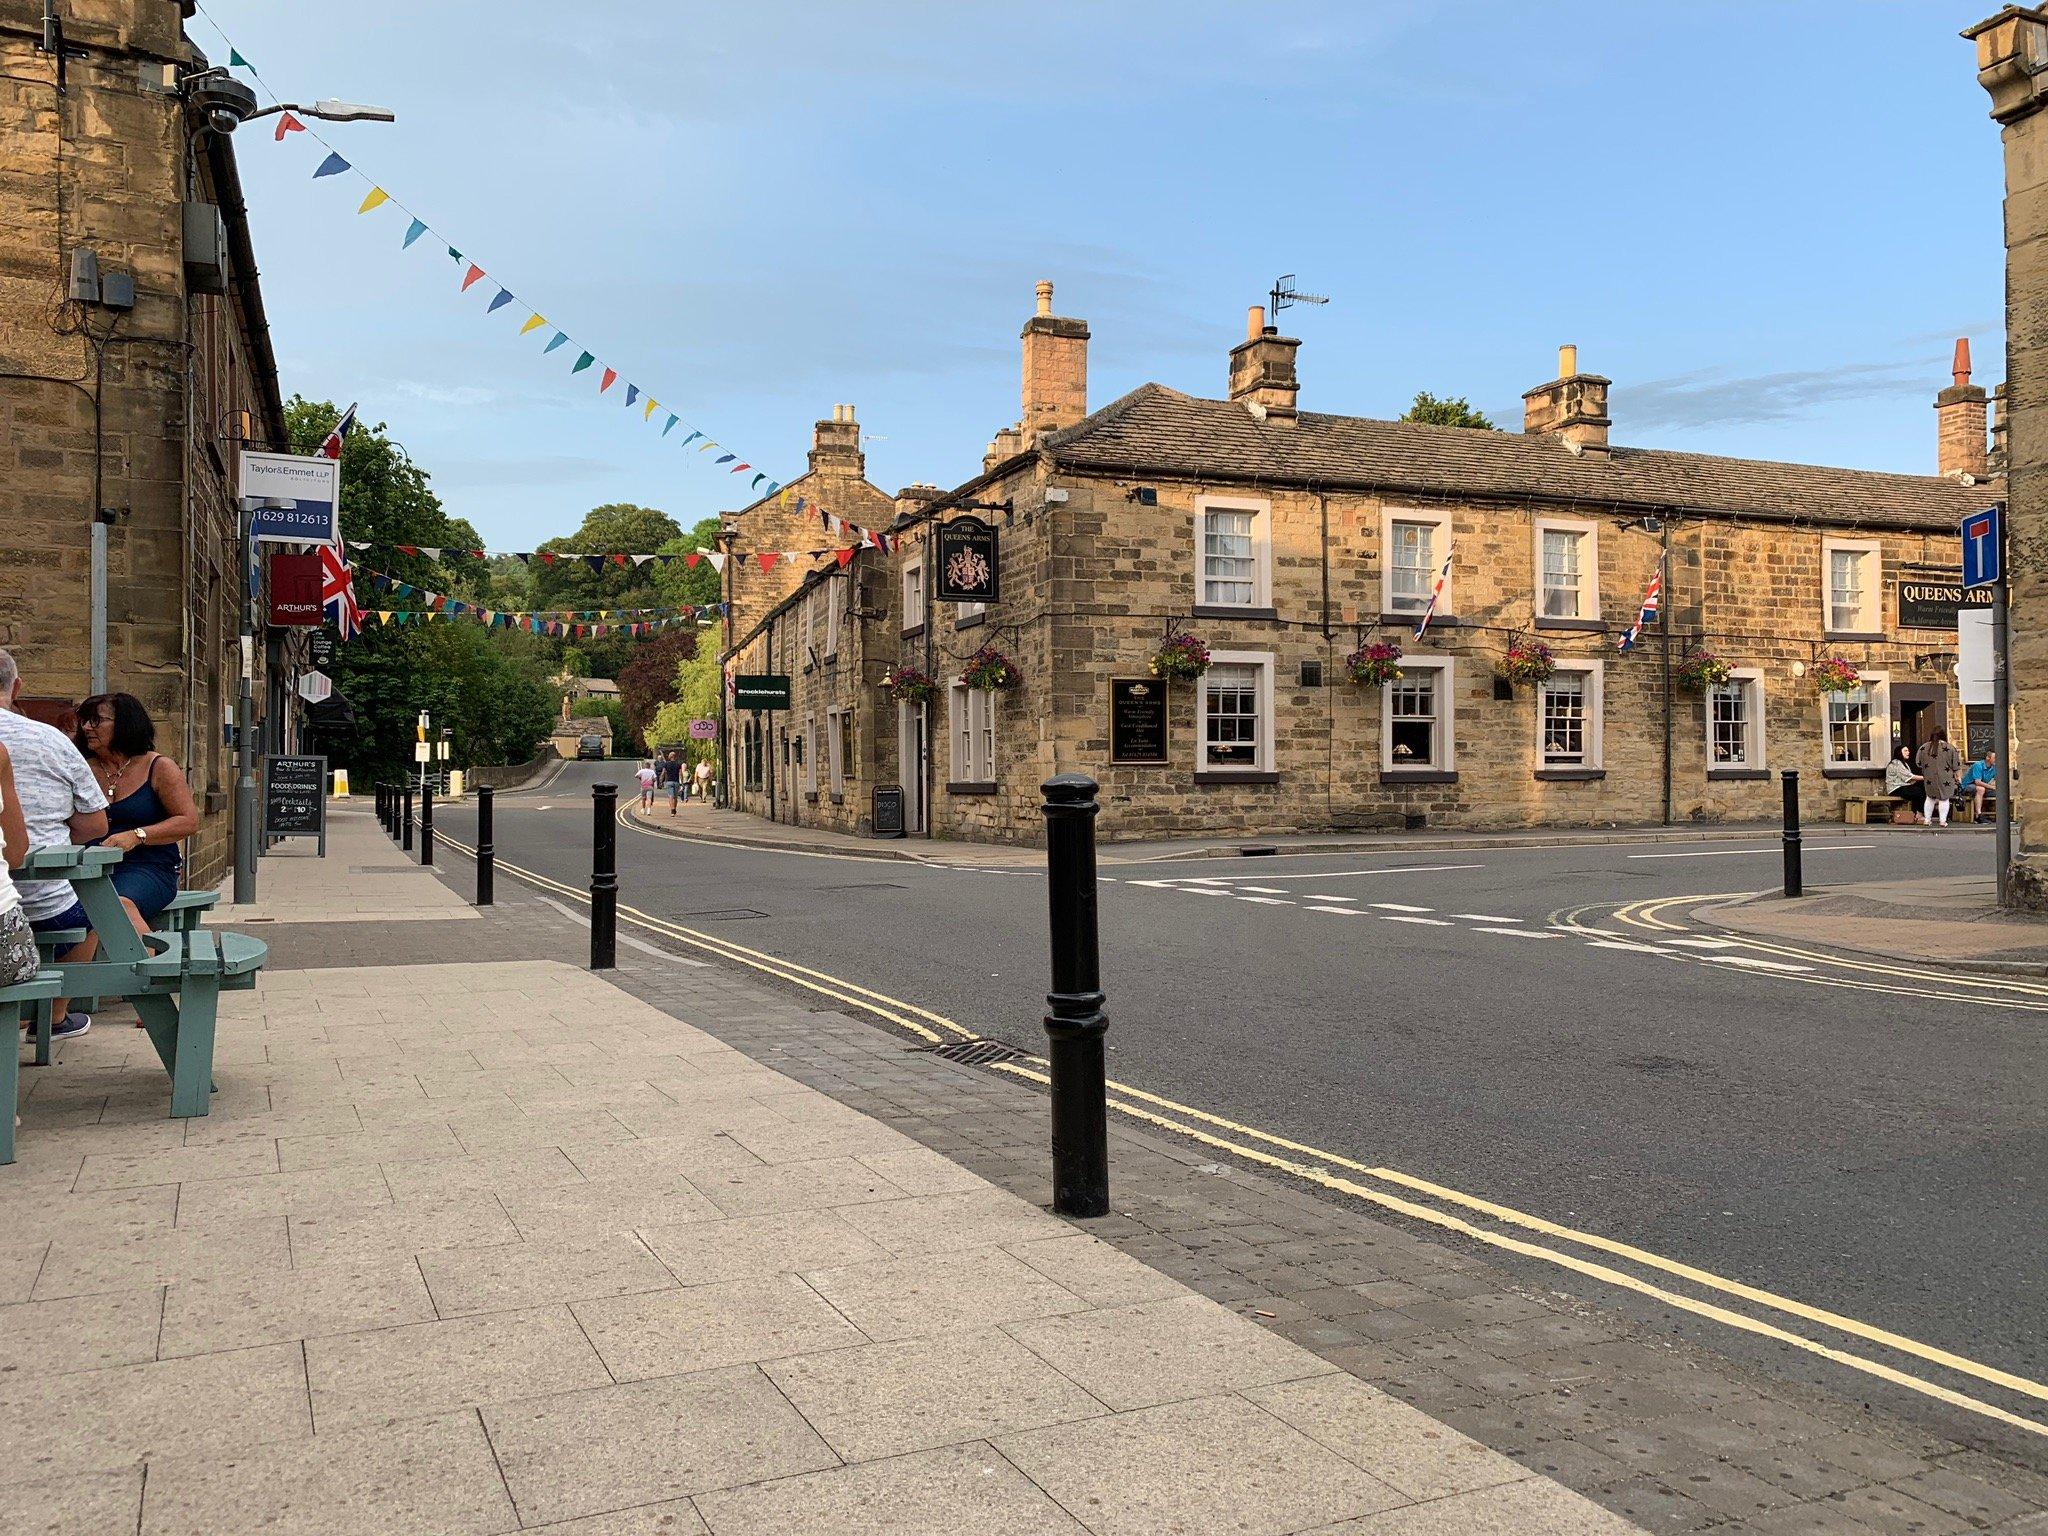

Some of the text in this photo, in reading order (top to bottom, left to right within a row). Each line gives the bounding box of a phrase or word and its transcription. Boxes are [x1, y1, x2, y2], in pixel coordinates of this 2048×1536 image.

[250, 464, 314, 477] Taylor&Emmet
[287, 512, 329, 525] 812613
[944, 533, 971, 541] QUEENS
[1903, 585, 1994, 604] QUEENS ARM
[277, 604, 317, 612] ARTHUR'S
